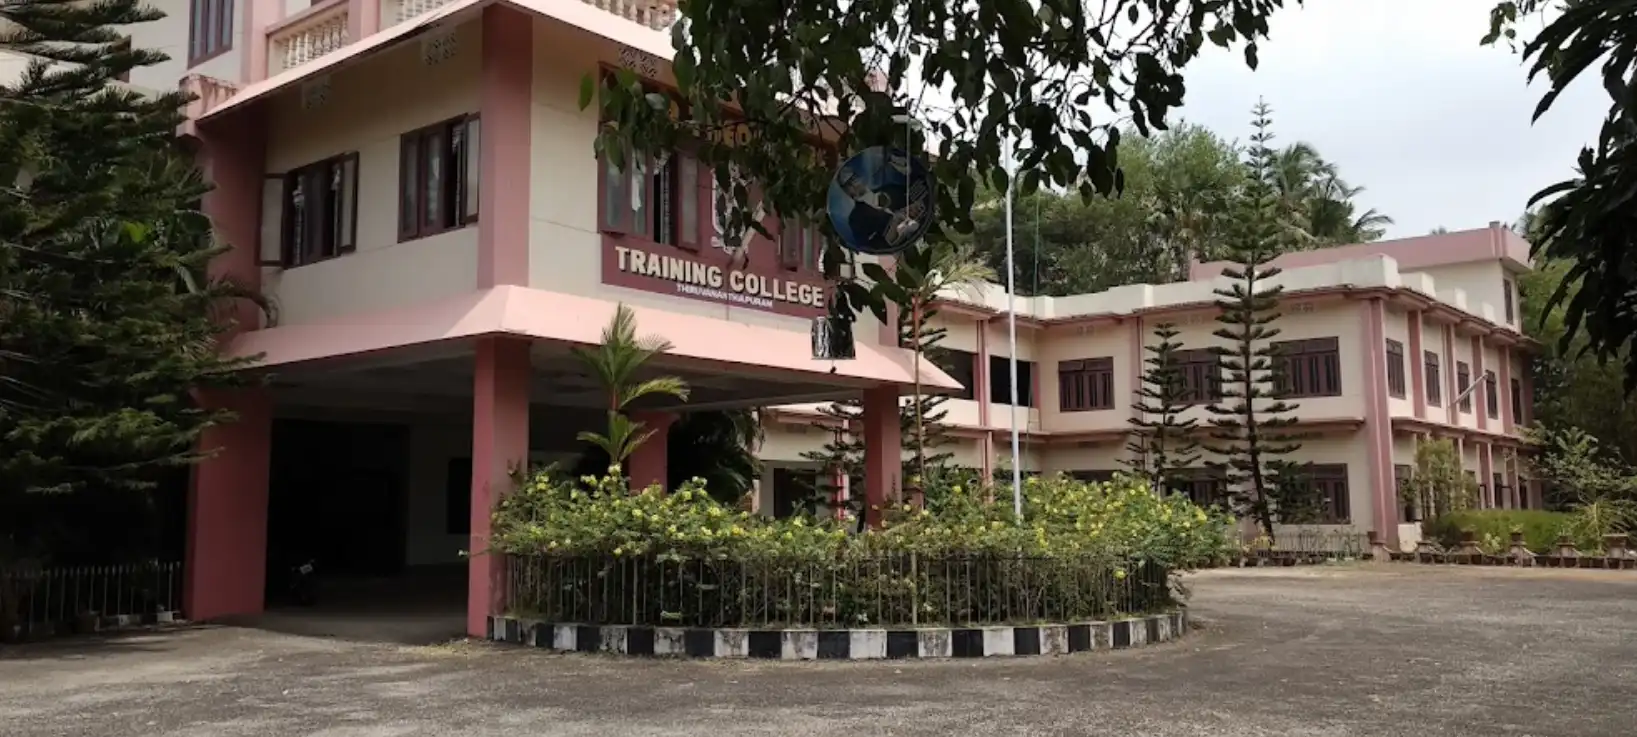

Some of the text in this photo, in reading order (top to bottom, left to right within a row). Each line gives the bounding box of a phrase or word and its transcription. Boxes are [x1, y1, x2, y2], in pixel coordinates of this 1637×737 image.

[615, 247, 824, 307] TRAINING COLLEGE
[676, 283, 773, 308] THIRUVANANTHAPURAM
